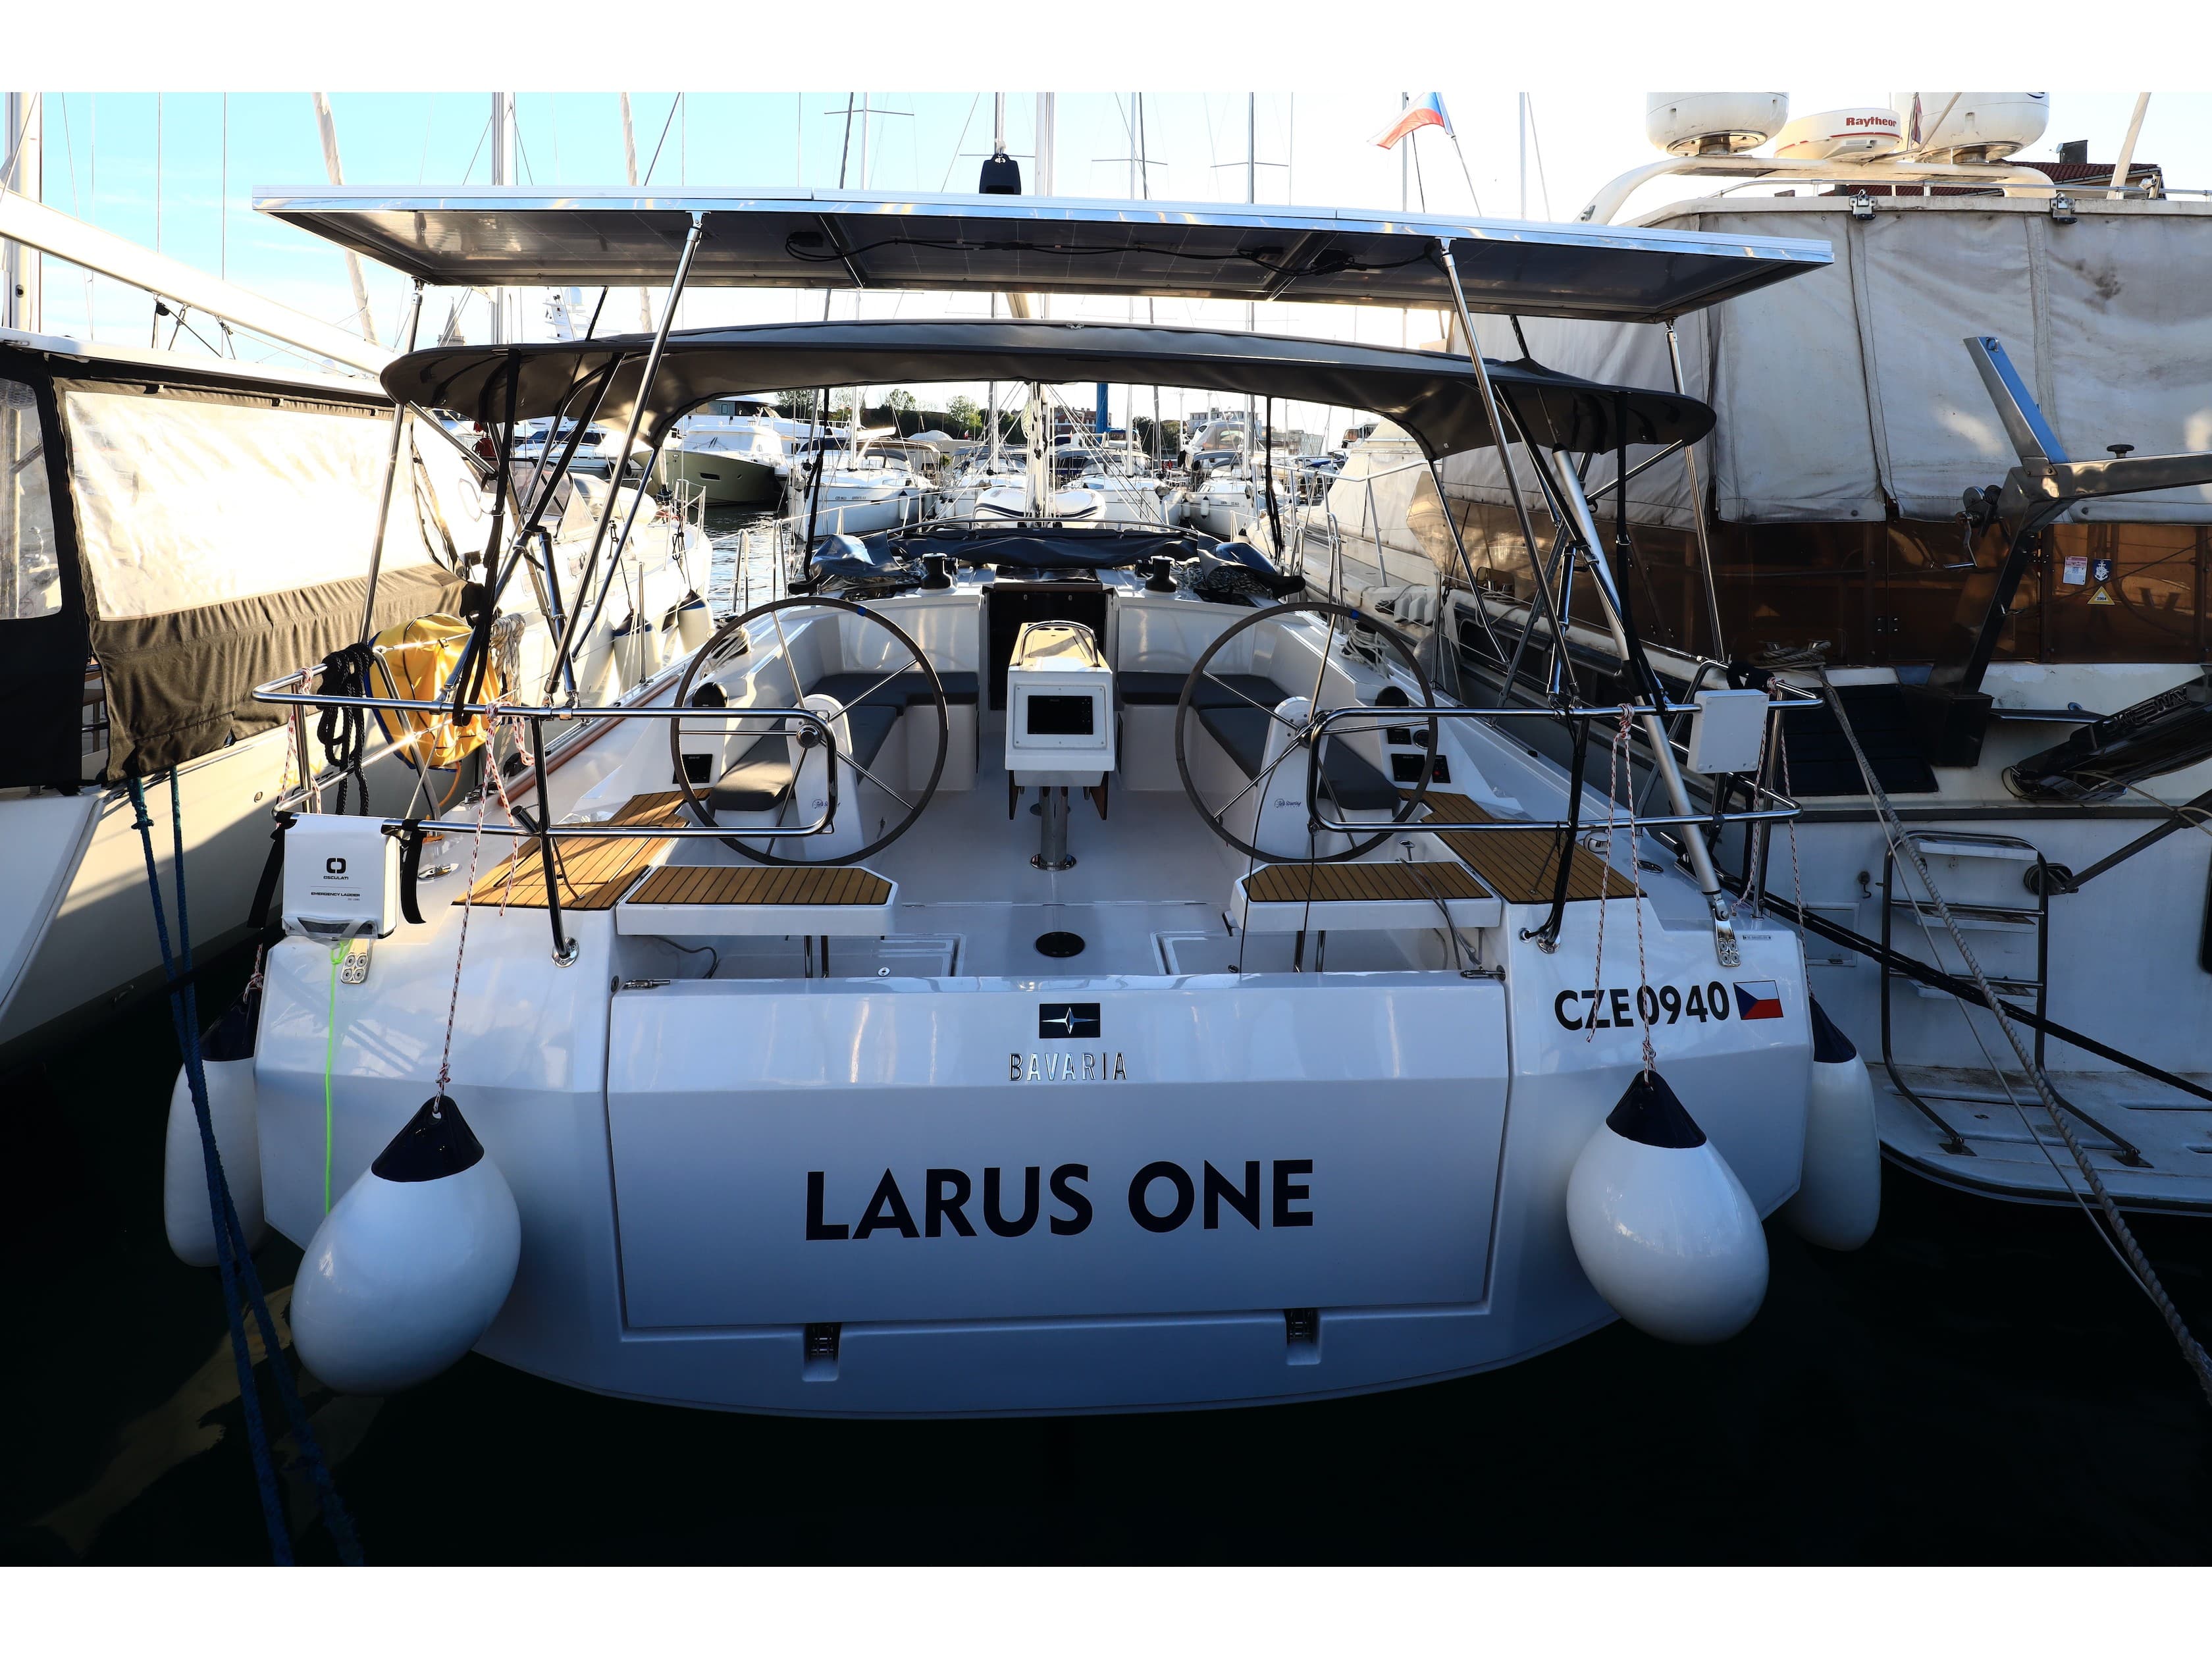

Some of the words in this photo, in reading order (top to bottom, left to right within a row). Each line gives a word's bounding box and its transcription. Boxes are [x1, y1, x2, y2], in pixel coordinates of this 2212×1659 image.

[1009, 1052, 1127, 1081] BAVARIA
[805, 1163, 1093, 1241] LARUS
[1127, 1159, 1314, 1233] ONE
